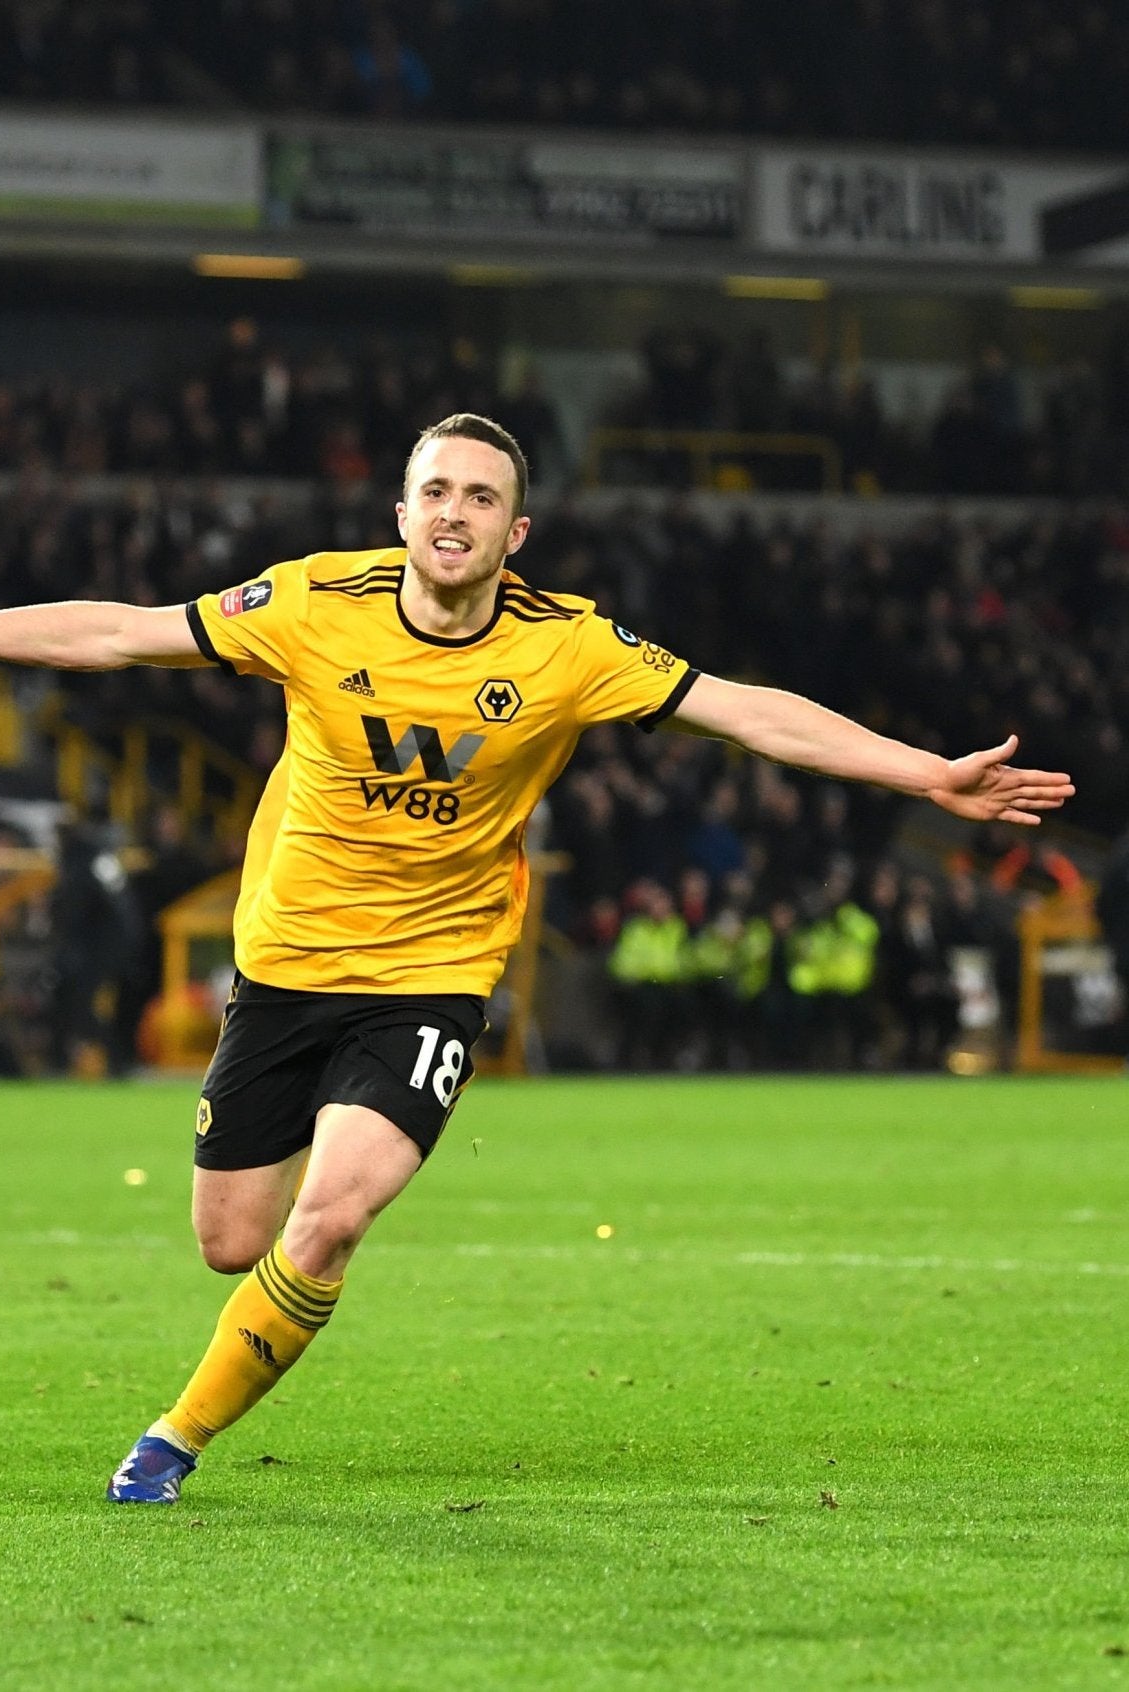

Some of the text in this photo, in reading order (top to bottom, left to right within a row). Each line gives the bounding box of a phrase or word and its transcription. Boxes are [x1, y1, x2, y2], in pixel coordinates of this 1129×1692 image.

[788, 158, 1007, 245] CARLING
[338, 680, 376, 698] adidas
[359, 776, 461, 826] W88
[409, 1025, 465, 1109] 18
